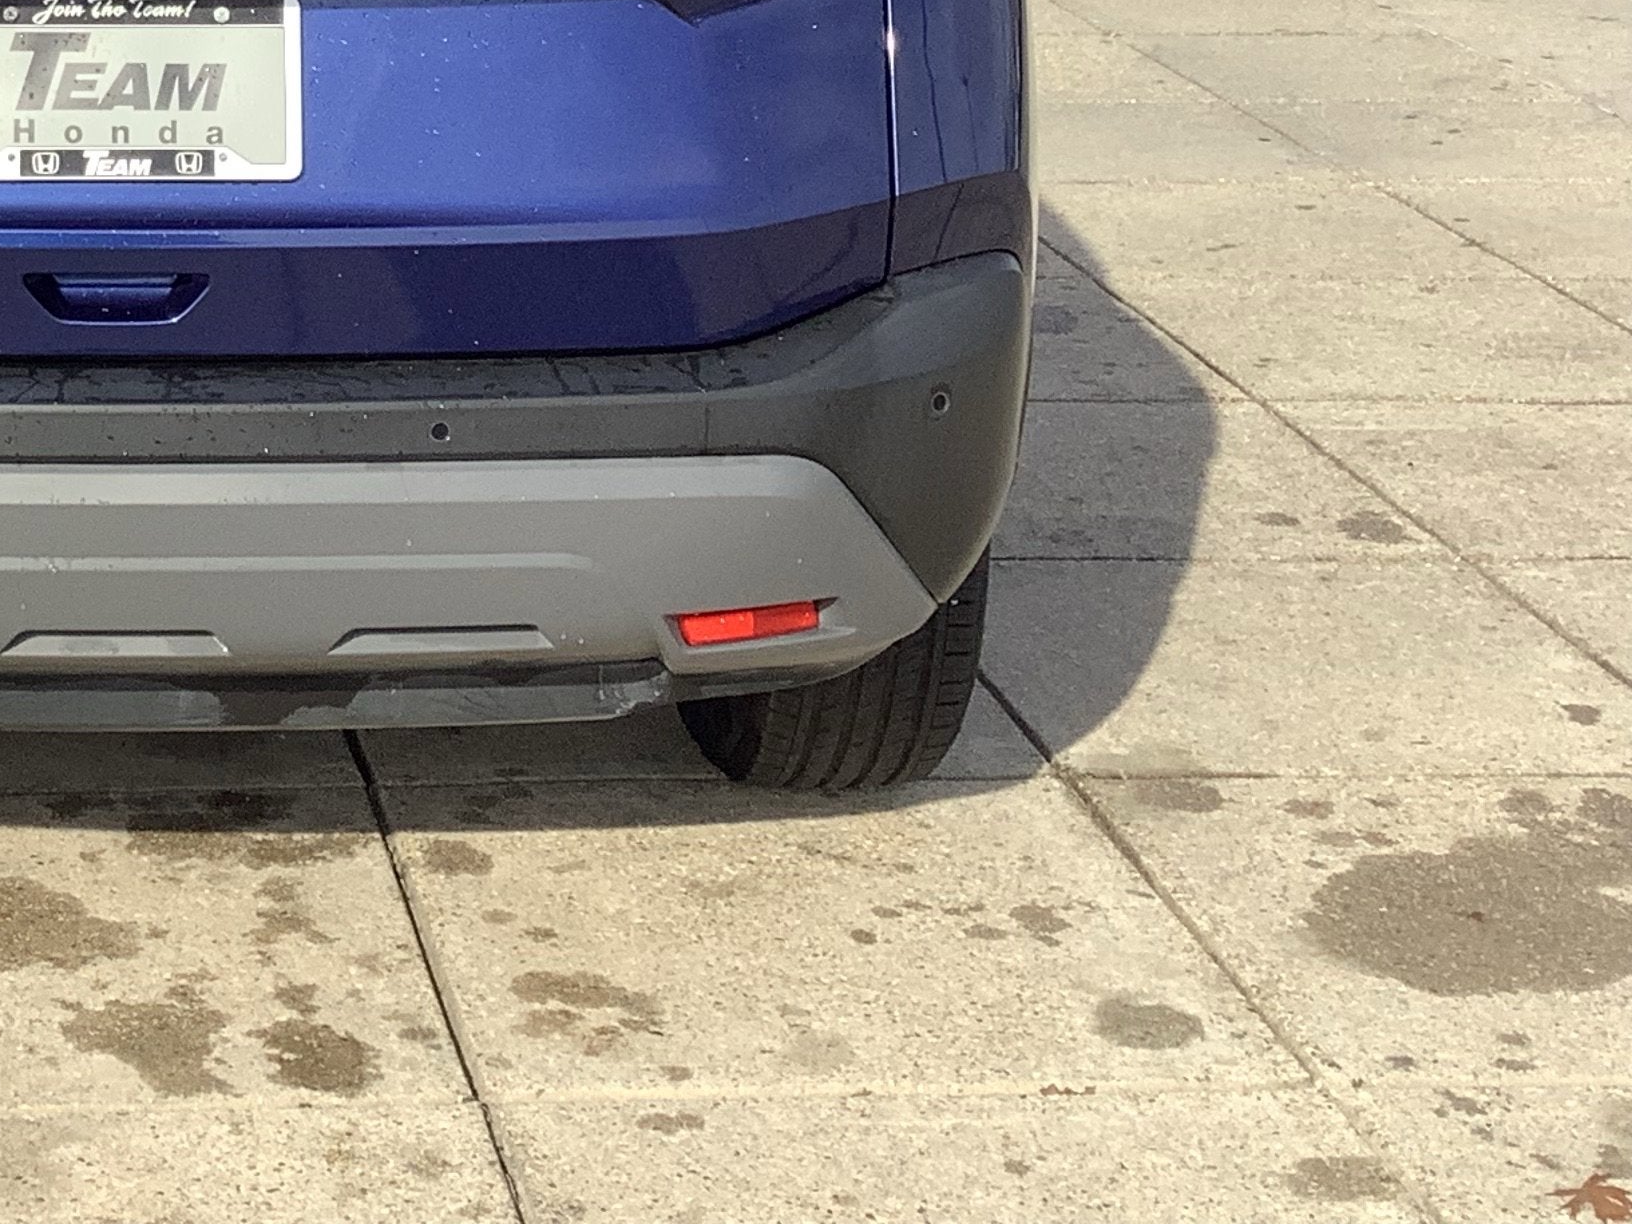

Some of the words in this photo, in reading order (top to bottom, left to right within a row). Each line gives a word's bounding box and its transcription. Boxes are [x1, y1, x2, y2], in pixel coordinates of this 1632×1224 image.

[9, 32, 228, 112] TEAM
[13, 118, 224, 144] Honda
[82, 150, 153, 176] TEAM
